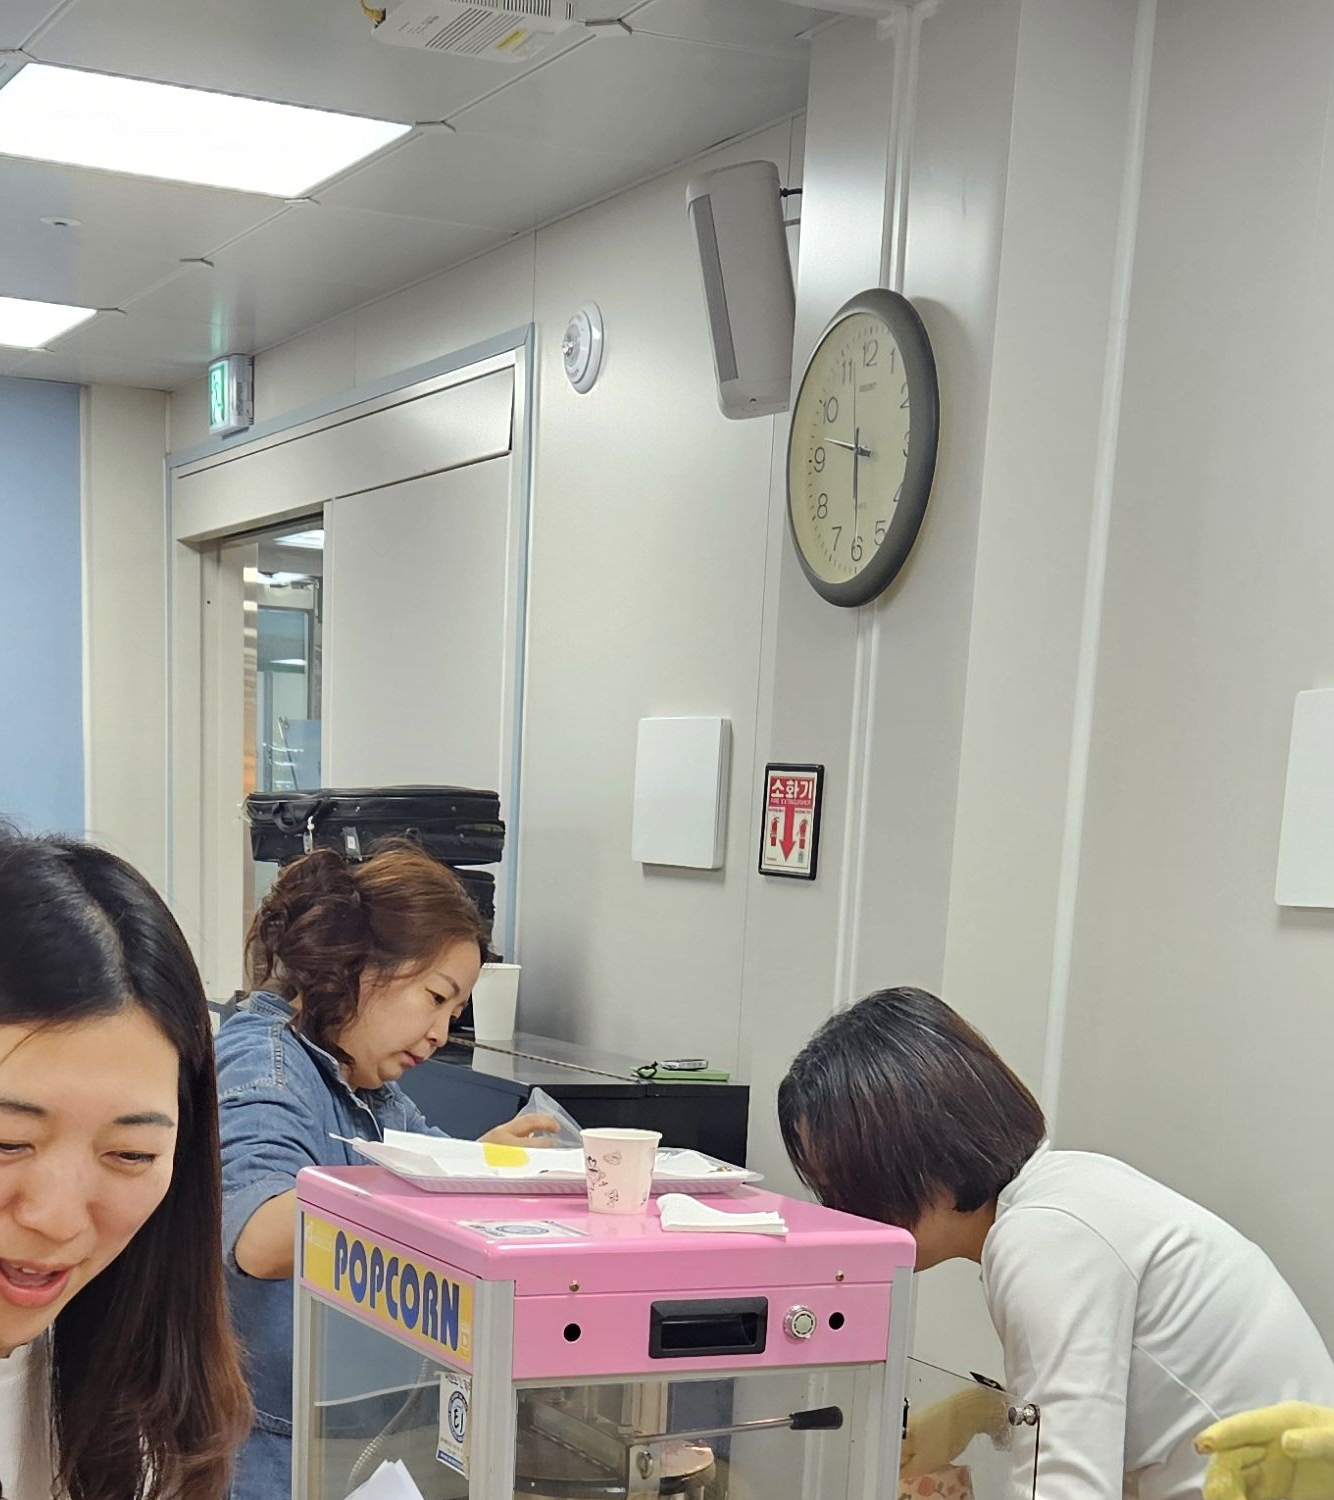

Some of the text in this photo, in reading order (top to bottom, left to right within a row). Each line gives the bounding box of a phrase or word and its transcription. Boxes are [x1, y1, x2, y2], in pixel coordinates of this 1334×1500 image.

[862, 339, 878, 367] 12
[890, 347, 896, 374] 1
[842, 359, 854, 385] 11
[820, 396, 839, 424] 10
[813, 446, 825, 473] 9
[817, 493, 828, 520] 8
[831, 526, 842, 552] 7
[874, 520, 886, 546] 5
[851, 535, 863, 562] 6
[770, 779, 813, 799] 소화기
[334, 1230, 460, 1351] POPCORN
